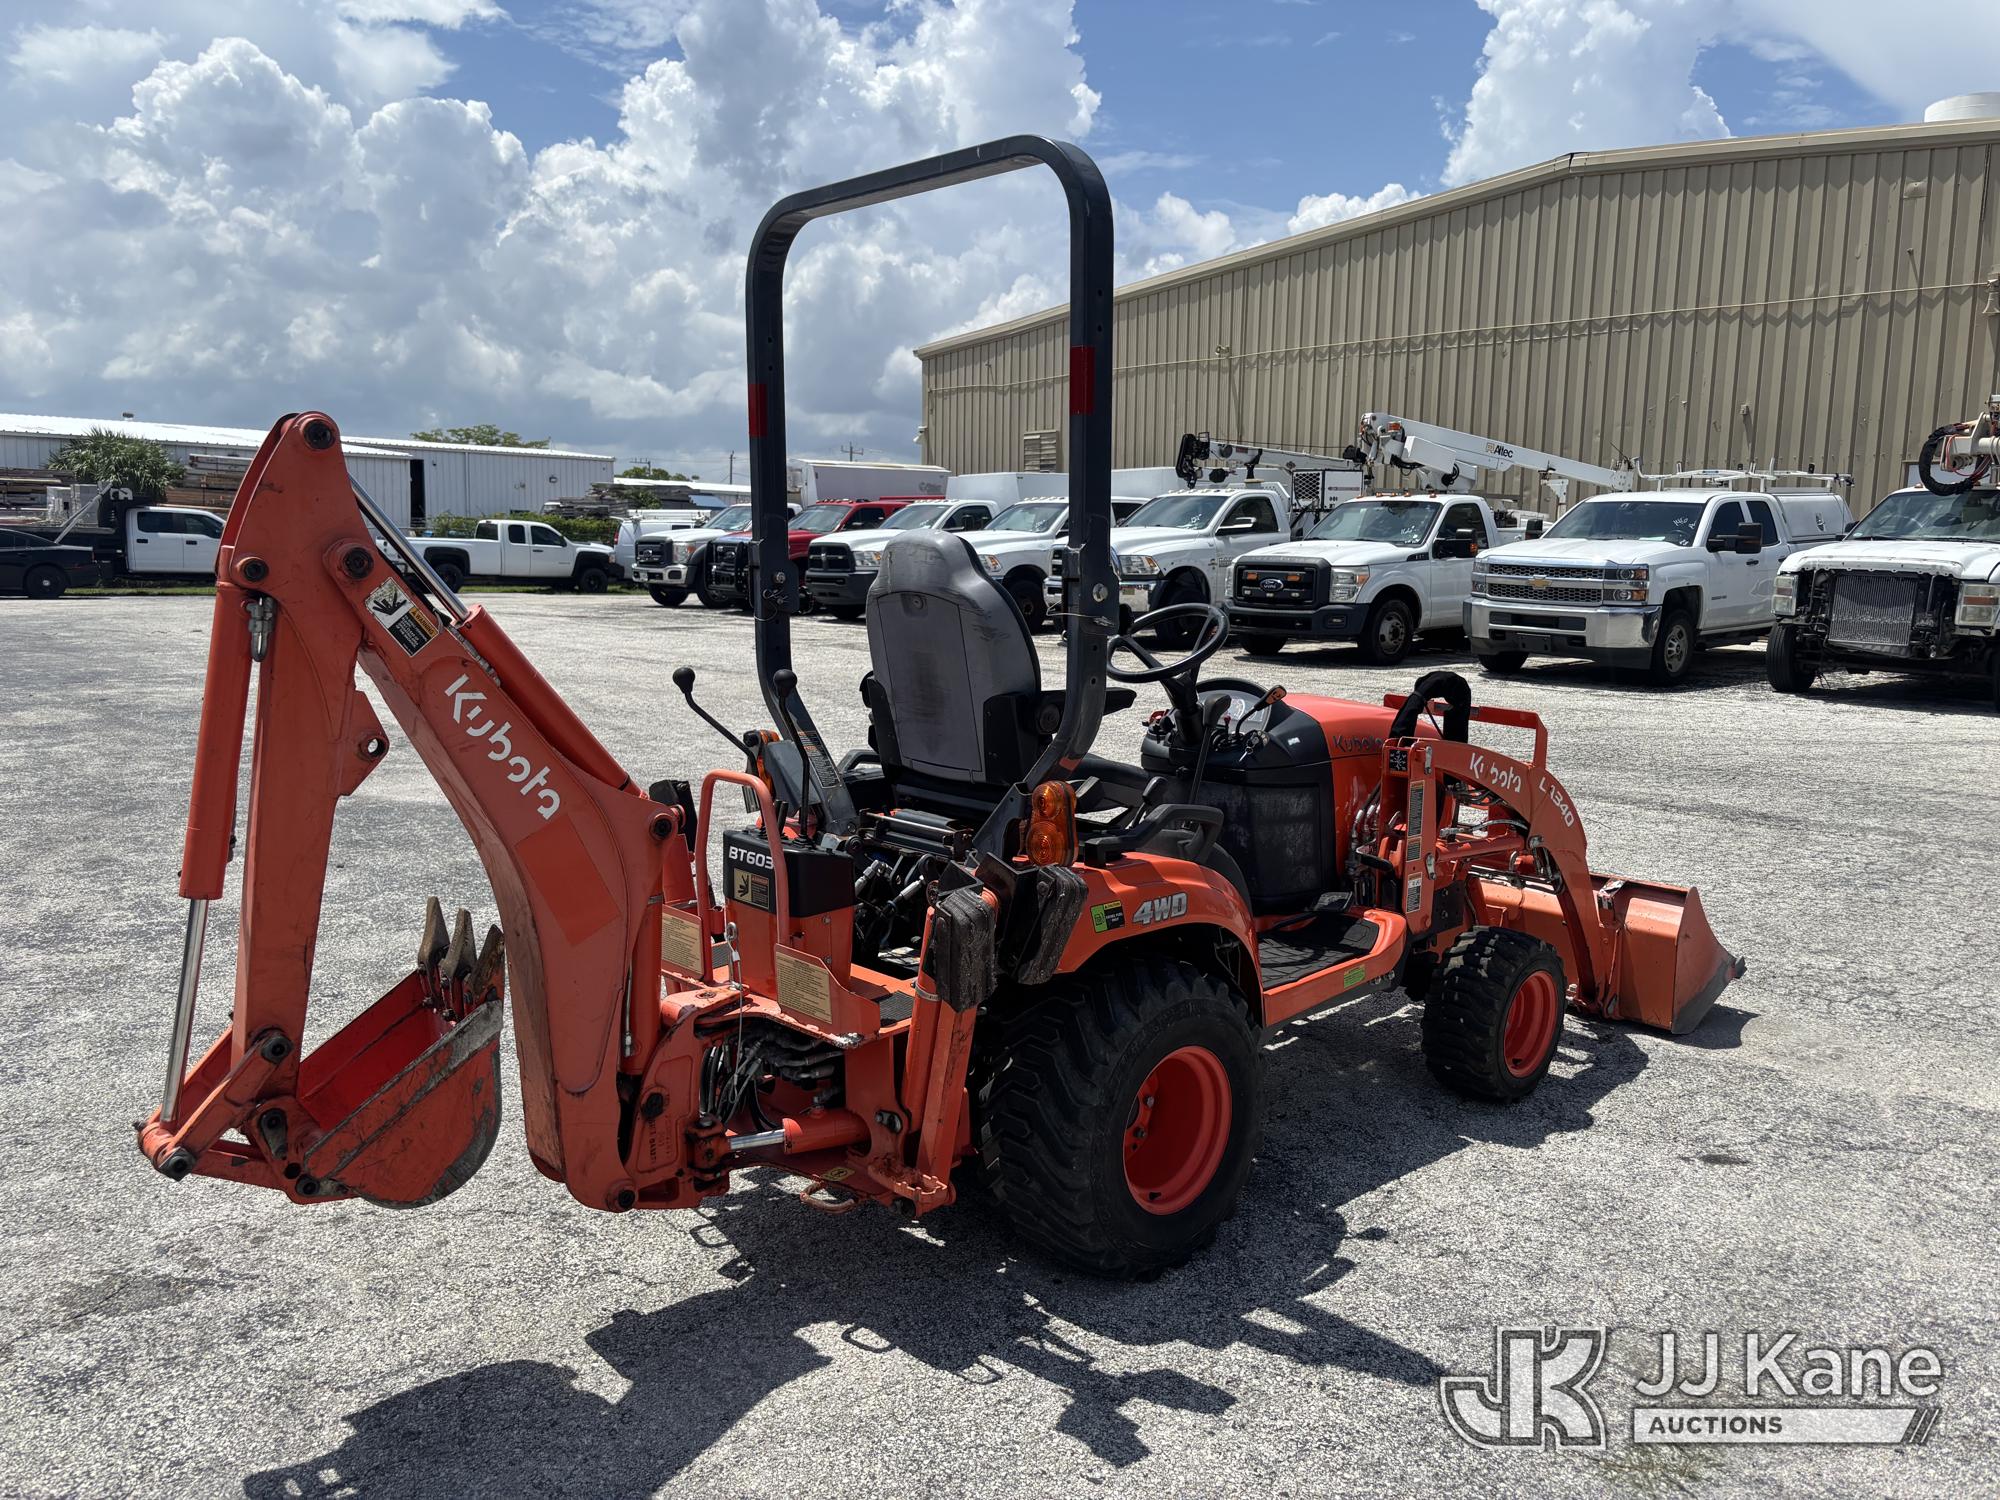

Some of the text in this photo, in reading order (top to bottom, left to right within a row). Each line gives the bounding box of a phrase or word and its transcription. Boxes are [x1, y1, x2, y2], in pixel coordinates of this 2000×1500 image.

[445, 674, 560, 820] Kubota
[728, 845, 774, 870] BT603
[1133, 892, 1188, 925] 4WD
